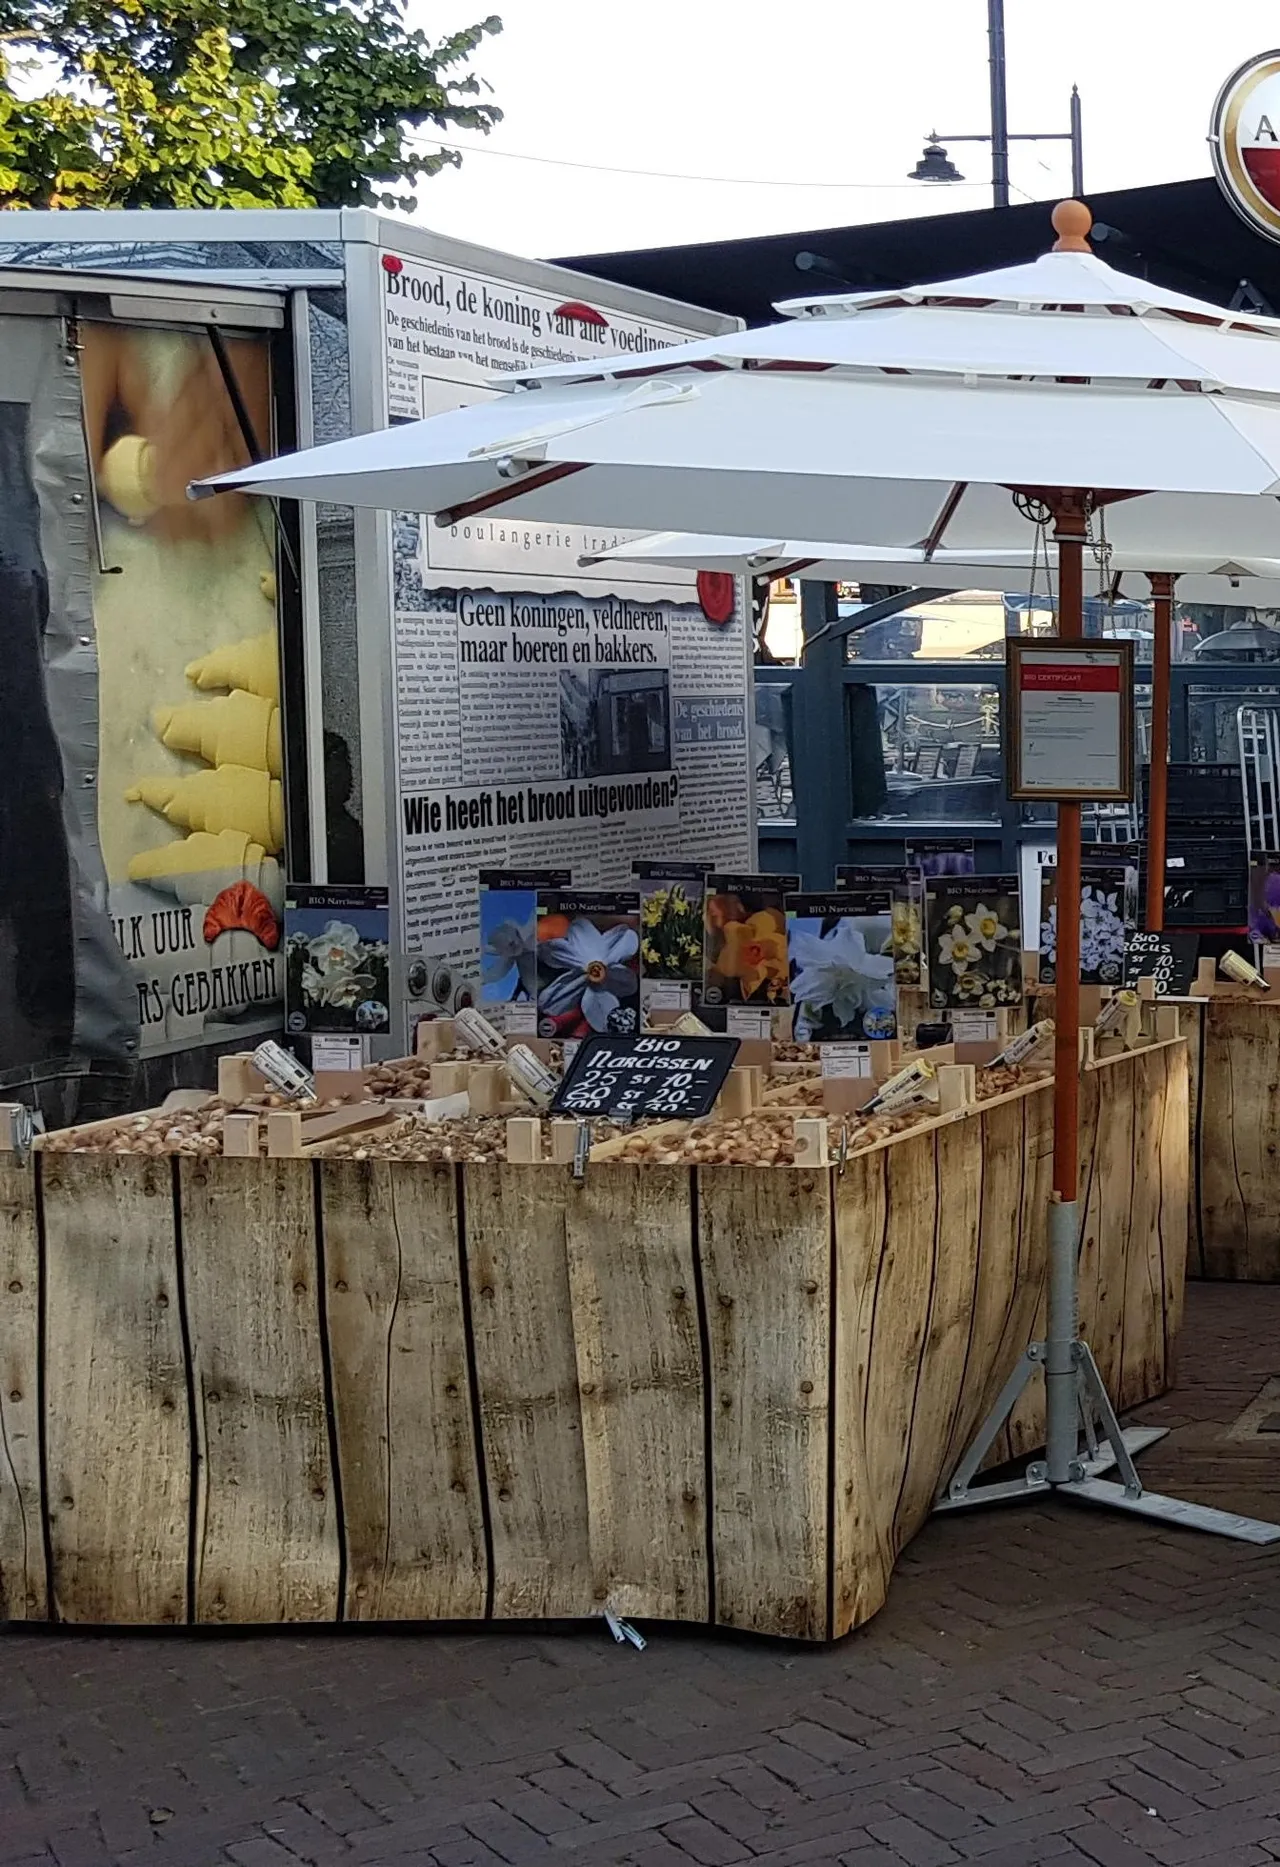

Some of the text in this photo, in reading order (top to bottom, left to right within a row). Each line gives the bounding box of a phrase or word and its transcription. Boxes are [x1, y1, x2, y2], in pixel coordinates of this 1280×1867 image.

[387, 272, 451, 314] Brood,
[456, 281, 478, 314] de
[482, 286, 542, 337] koning
[546, 310, 575, 338] van
[387, 309, 400, 326] De
[401, 315, 455, 338] geschiedenis
[456, 329, 471, 342] van
[473, 328, 486, 345] het
[487, 332, 511, 351] brood
[512, 339, 519, 353] is
[520, 339, 530, 355] de
[388, 336, 404, 351] van
[407, 335, 421, 353] het
[423, 340, 456, 359] bestaan
[476, 351, 489, 367] het
[460, 594, 668, 637] Geen koningen, veldheren,
[460, 632, 658, 663] maar boeren en bakkers.
[675, 700, 688, 718] De
[675, 727, 692, 742] van
[698, 723, 712, 740] het
[404, 774, 678, 835] Wie heeft het brood uitgevonden?
[308, 896, 325, 906] BIO
[560, 902, 577, 911] BIO
[809, 905, 827, 914] BIO
[108, 907, 195, 960] LK UUR
[1124, 941, 1171, 953] ROCUS
[171, 958, 278, 1017] GEBAKKEN
[574, 1070, 624, 1088] 25
[566, 1087, 611, 1101] 60
